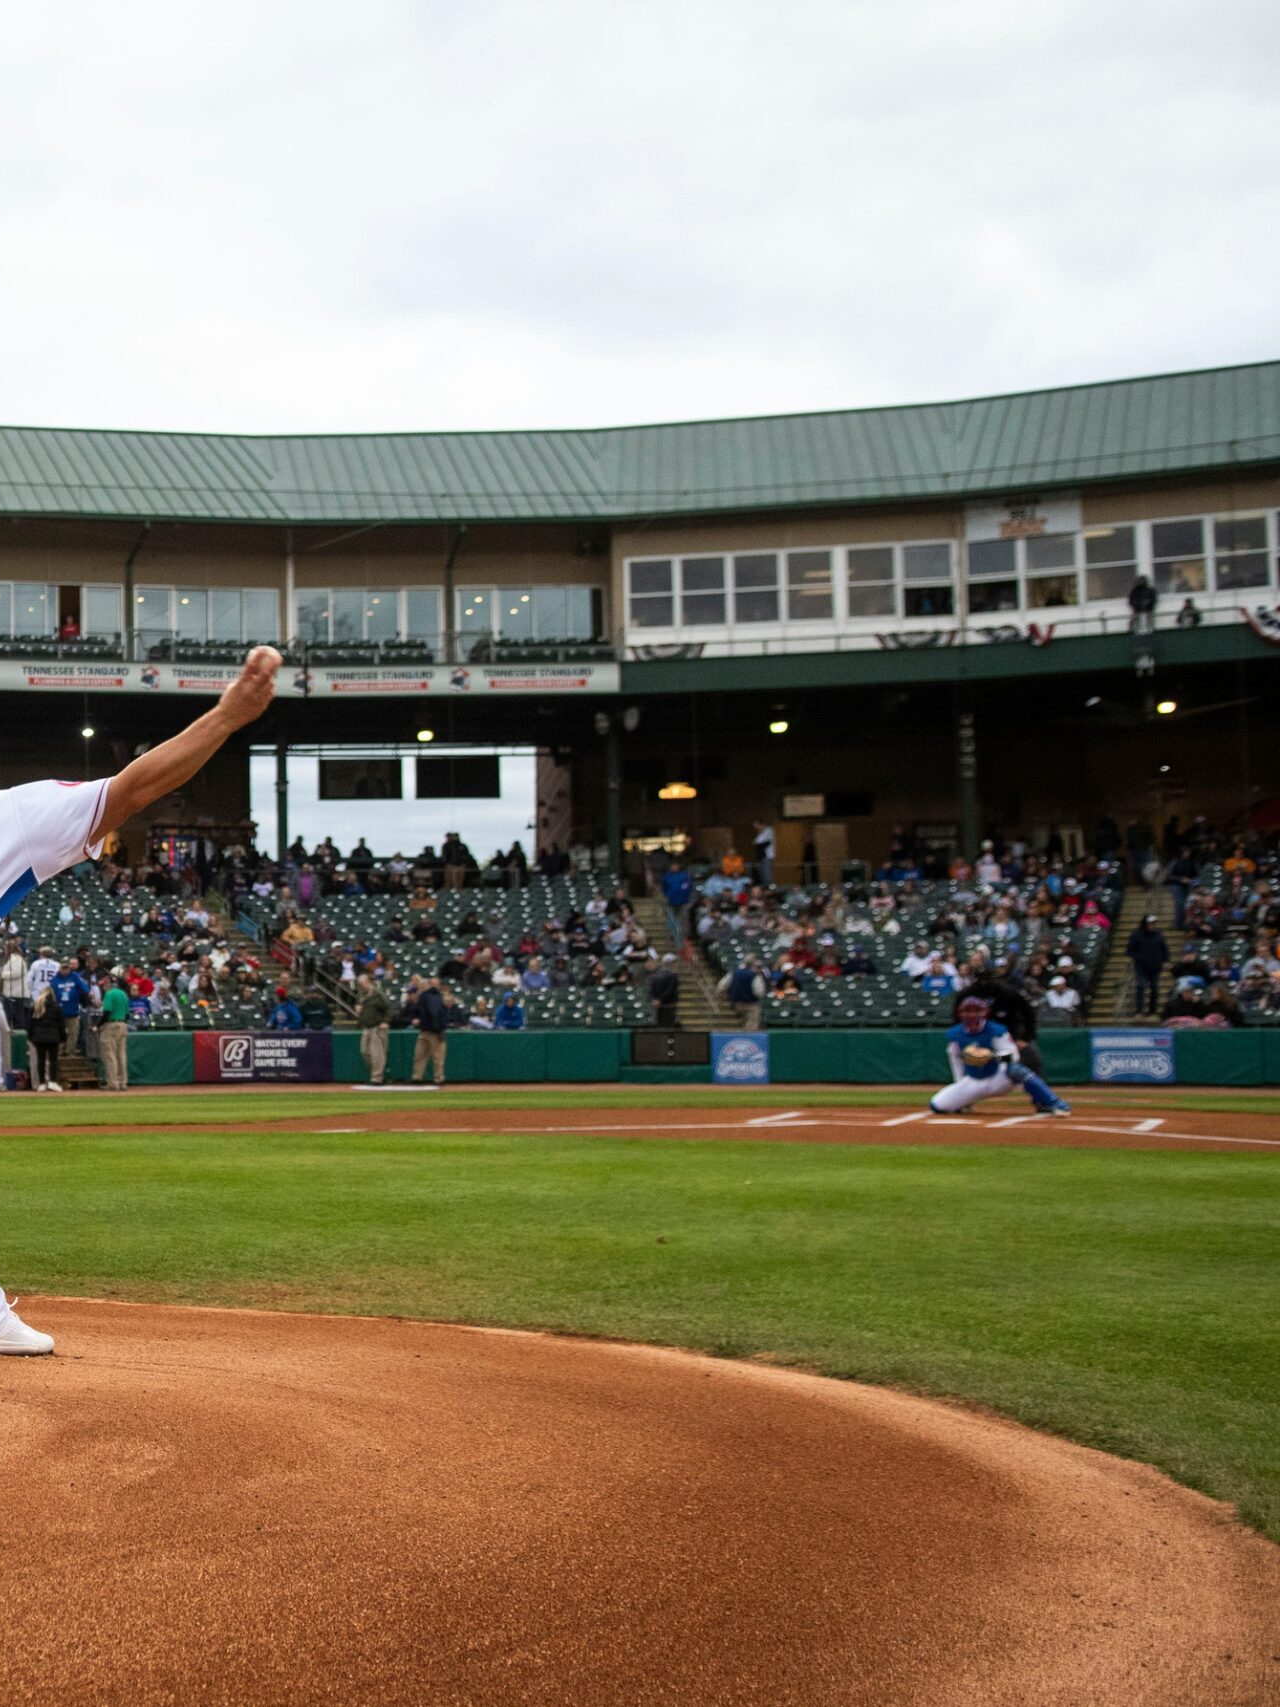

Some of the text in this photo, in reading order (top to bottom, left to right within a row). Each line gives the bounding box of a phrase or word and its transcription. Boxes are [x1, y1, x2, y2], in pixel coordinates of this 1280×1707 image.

[22, 666, 130, 676] TENNESSEE STANDARD
[255, 1039, 308, 1048] WATCH EVERY
[255, 1058, 297, 1067] GAME FREE
